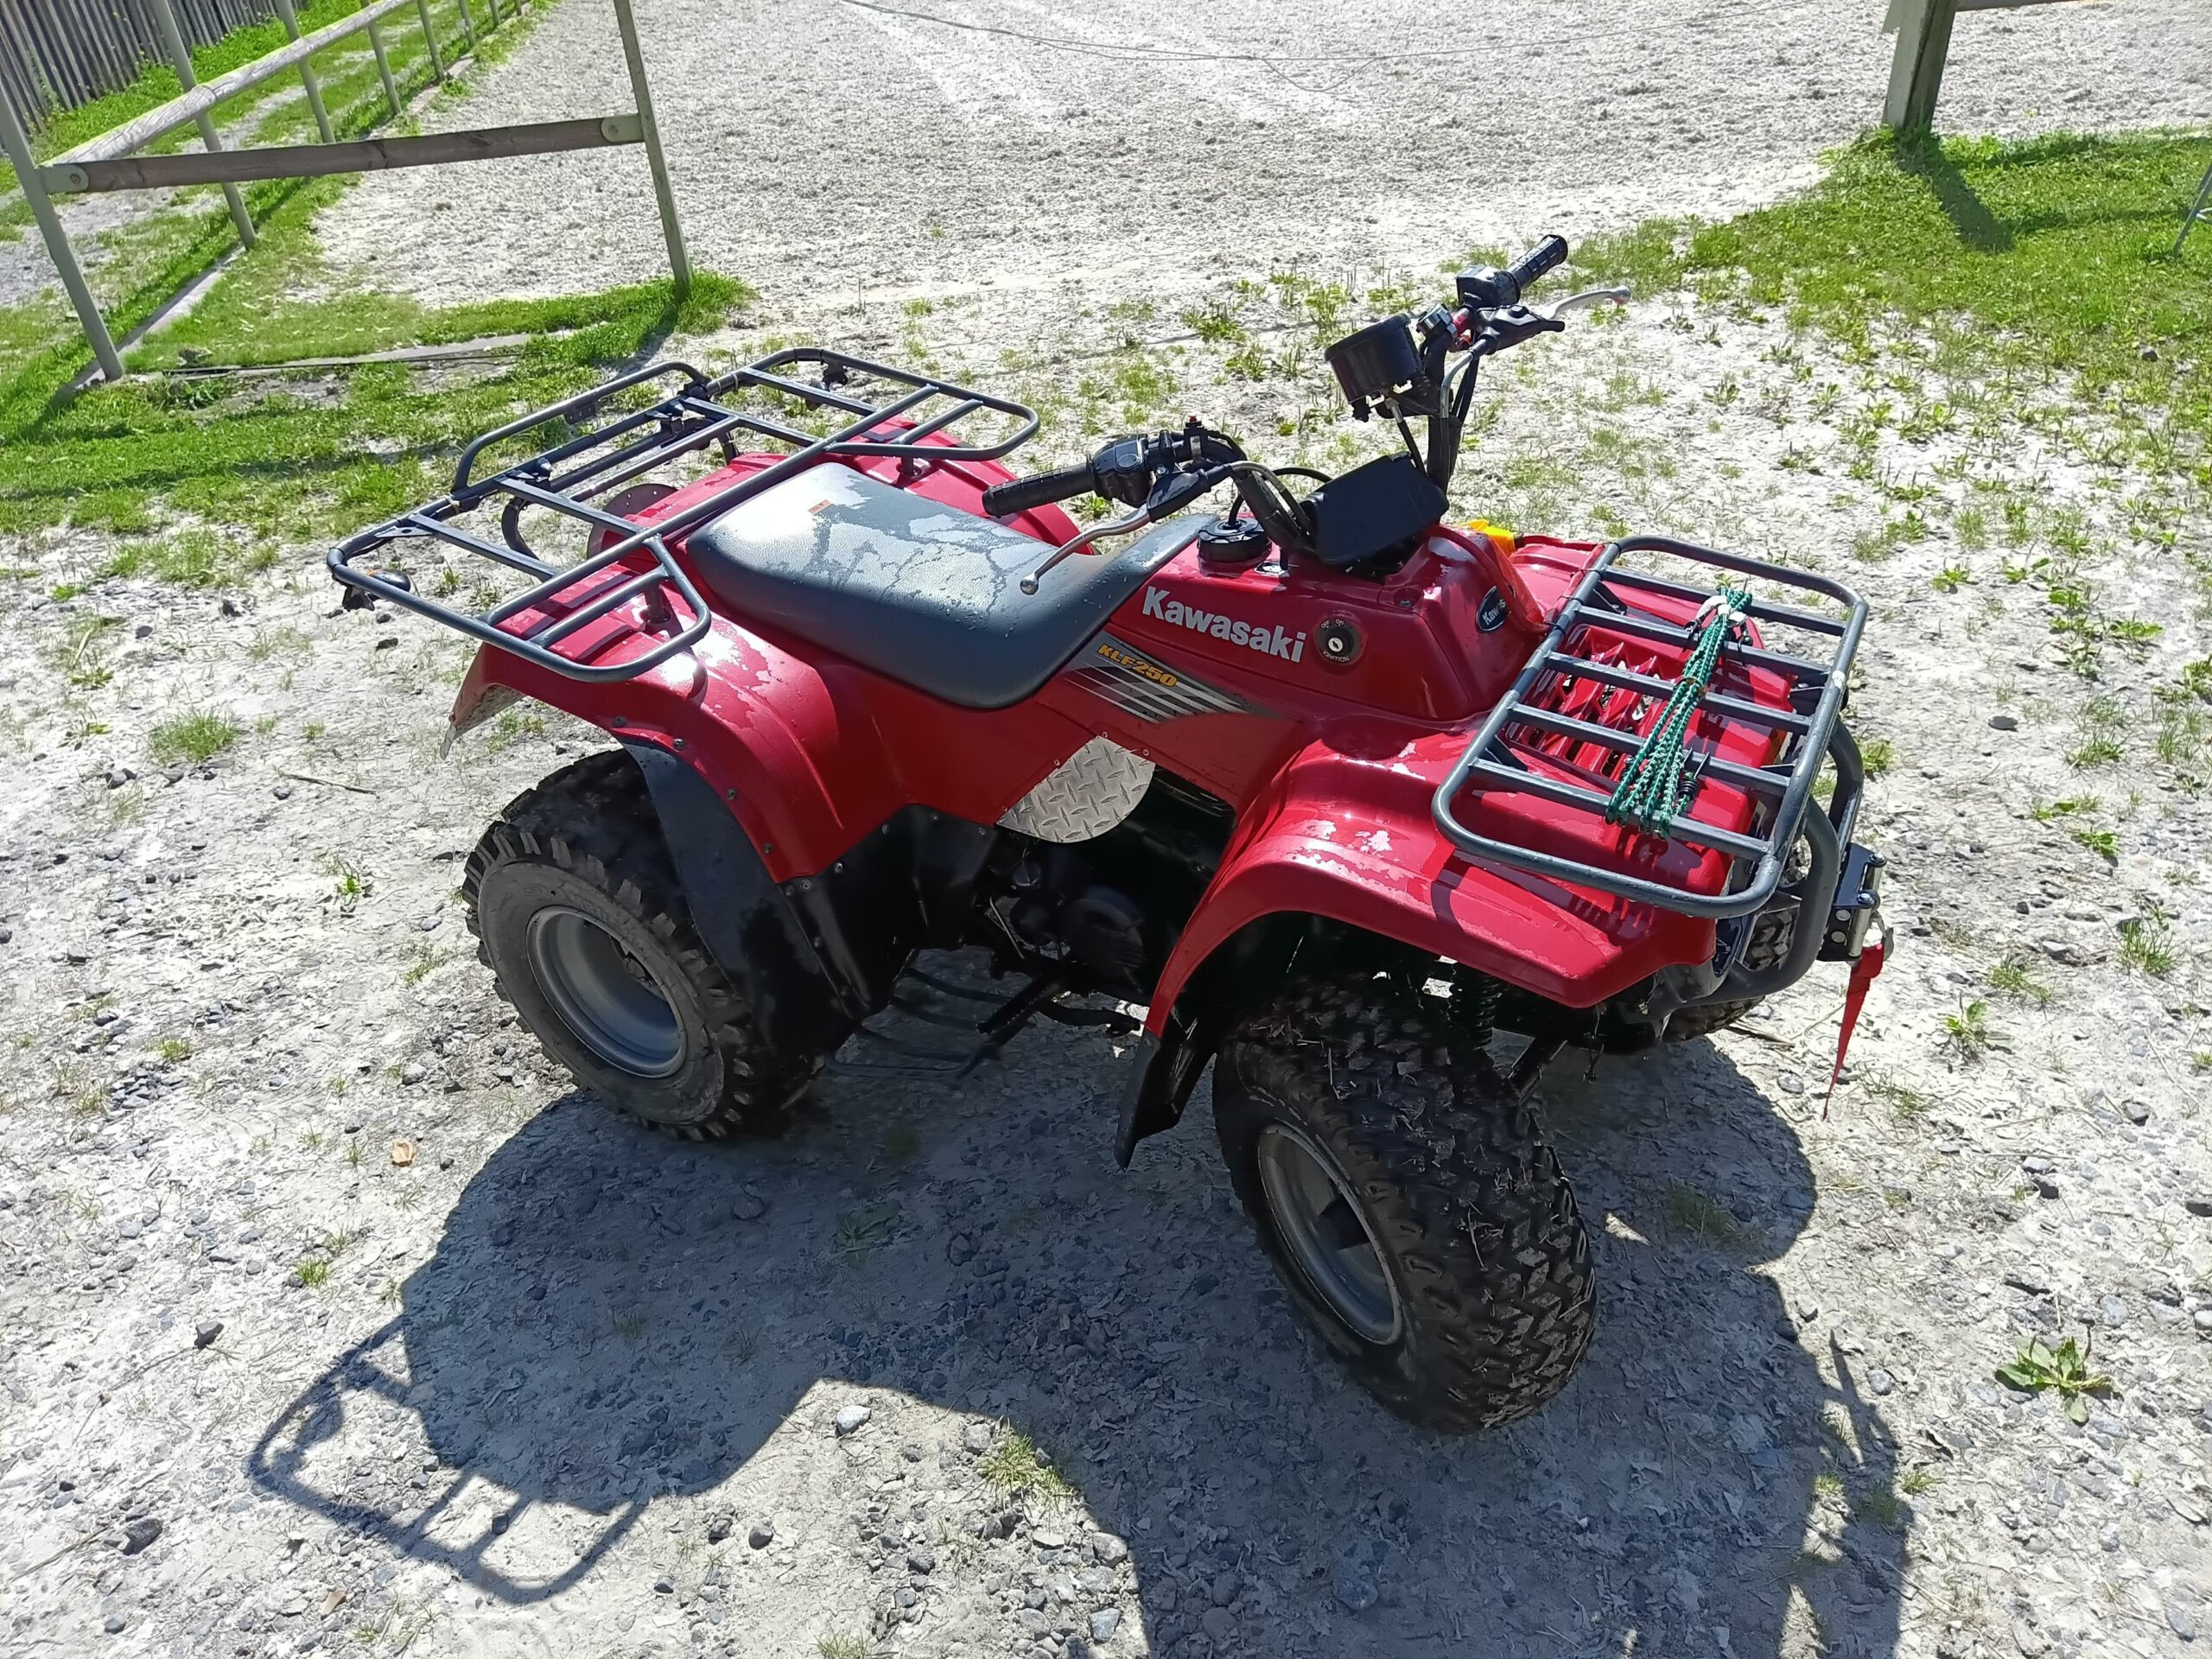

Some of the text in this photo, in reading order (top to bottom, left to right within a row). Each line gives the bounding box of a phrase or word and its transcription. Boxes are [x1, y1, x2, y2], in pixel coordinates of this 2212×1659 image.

[1142, 586, 1306, 663] Kawasaki
[1320, 620, 1330, 629] OFF
[1097, 644, 1178, 688] KLF250
[1322, 650, 1350, 663] IGNITION
